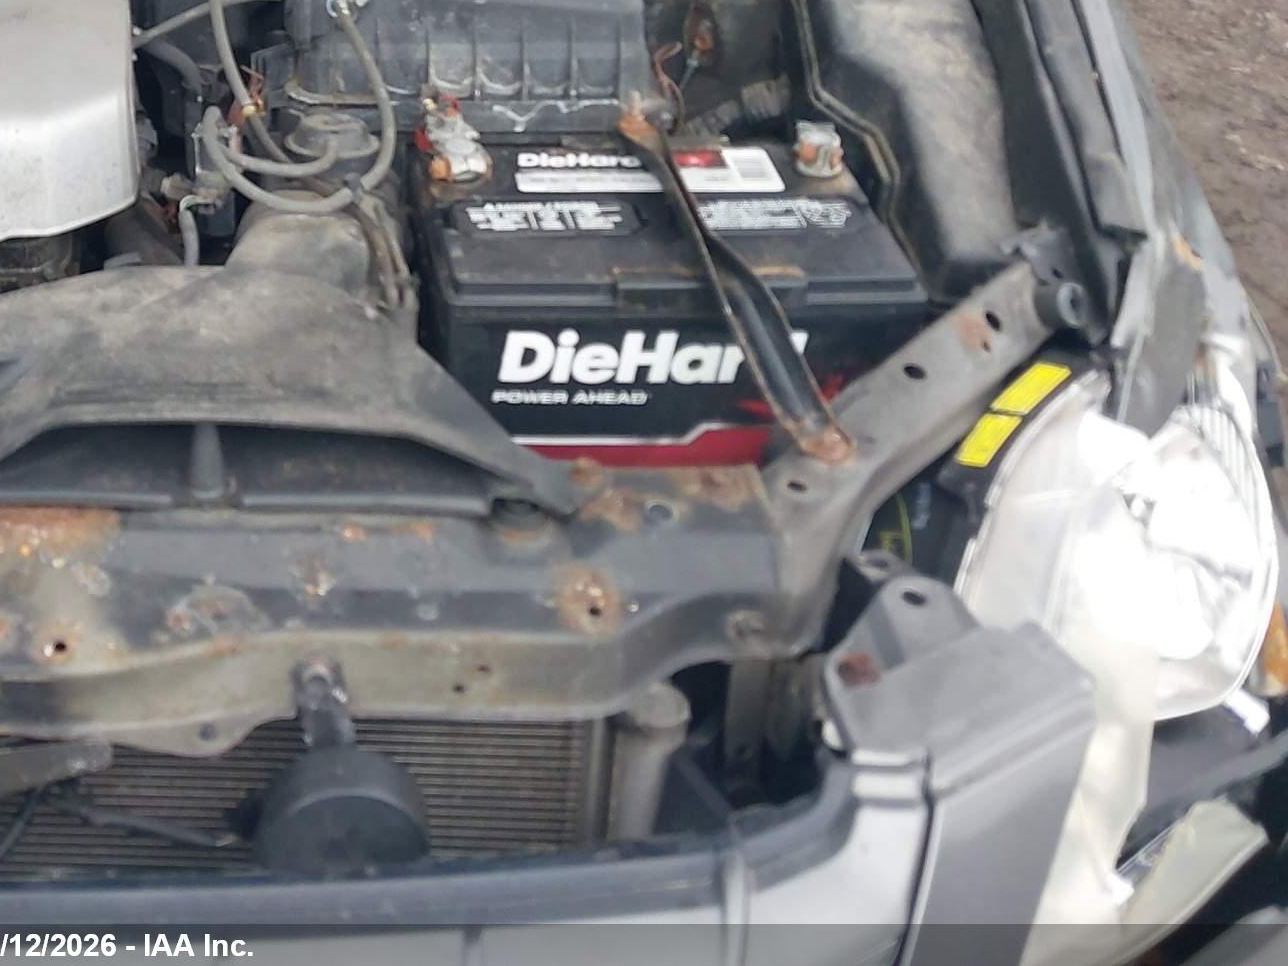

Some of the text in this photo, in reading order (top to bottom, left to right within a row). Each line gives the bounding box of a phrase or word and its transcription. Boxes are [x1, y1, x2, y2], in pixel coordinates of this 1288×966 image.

[497, 328, 810, 385] DieHar
[491, 389, 647, 404] POWER AHEAD
